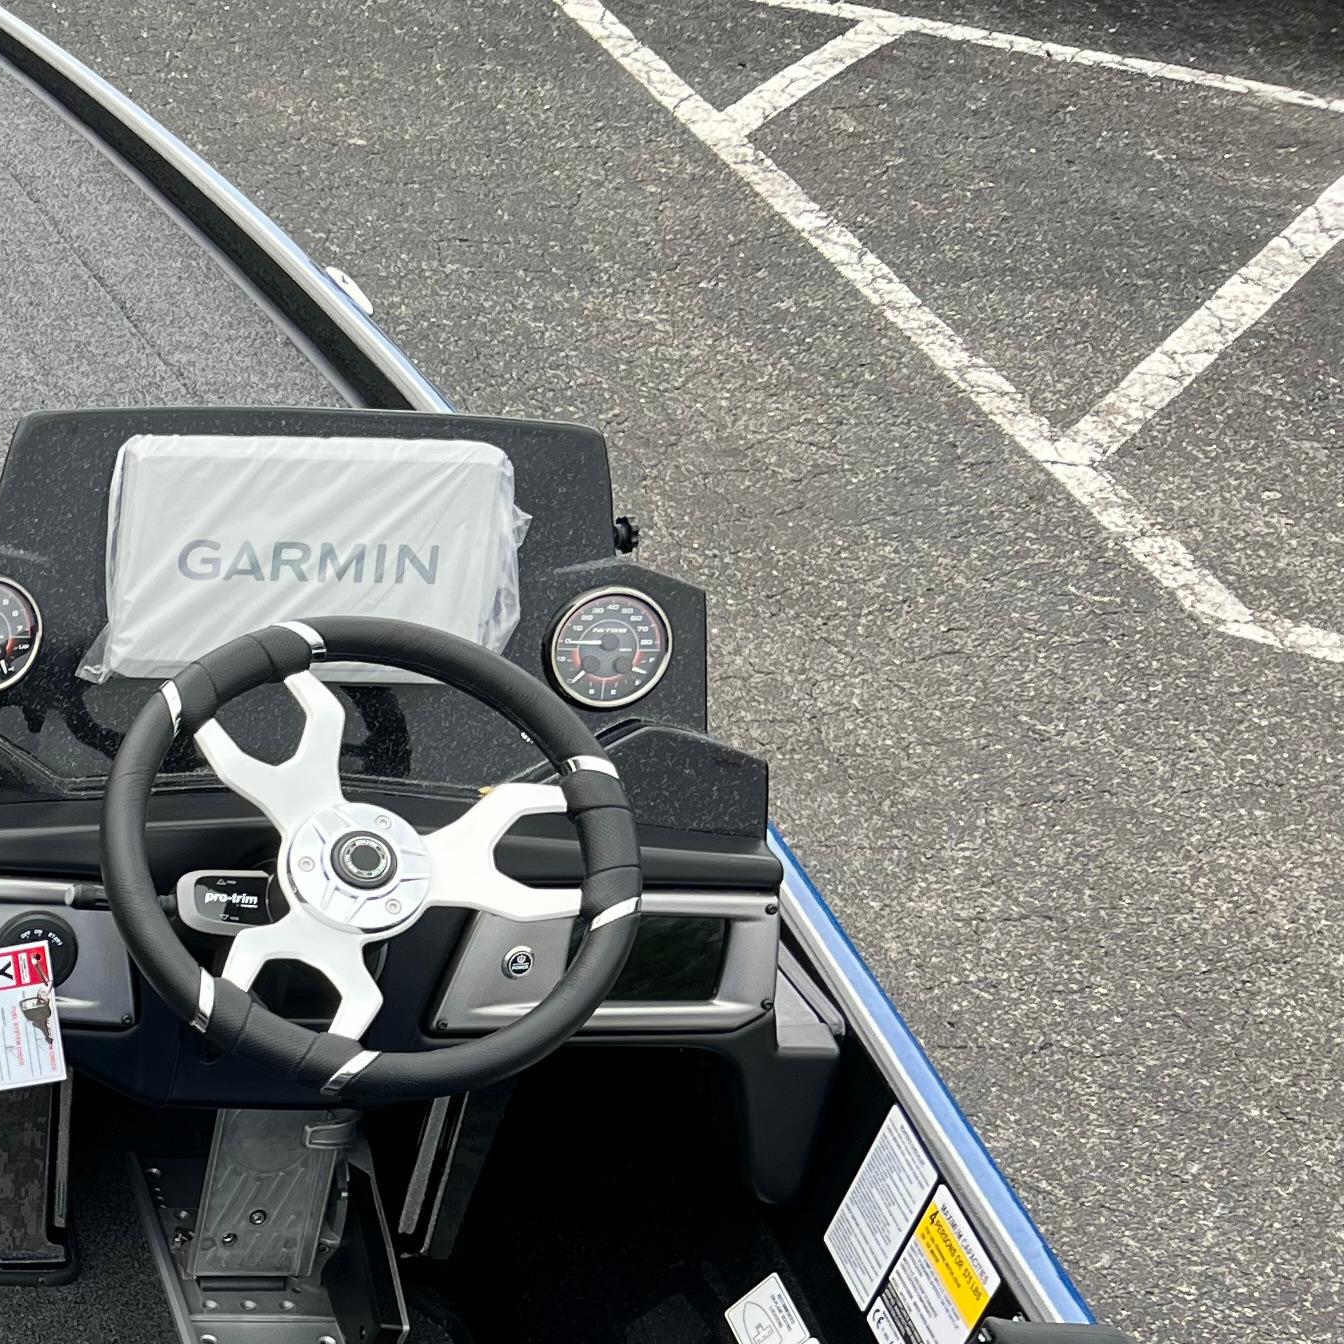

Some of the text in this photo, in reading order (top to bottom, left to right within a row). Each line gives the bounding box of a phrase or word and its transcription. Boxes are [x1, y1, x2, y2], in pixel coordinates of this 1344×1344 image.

[177, 538, 440, 585] GARMIN
[204, 892, 258, 905] pro-trim
[927, 1206, 940, 1227] 4
[933, 1218, 957, 1259] PERSONS
